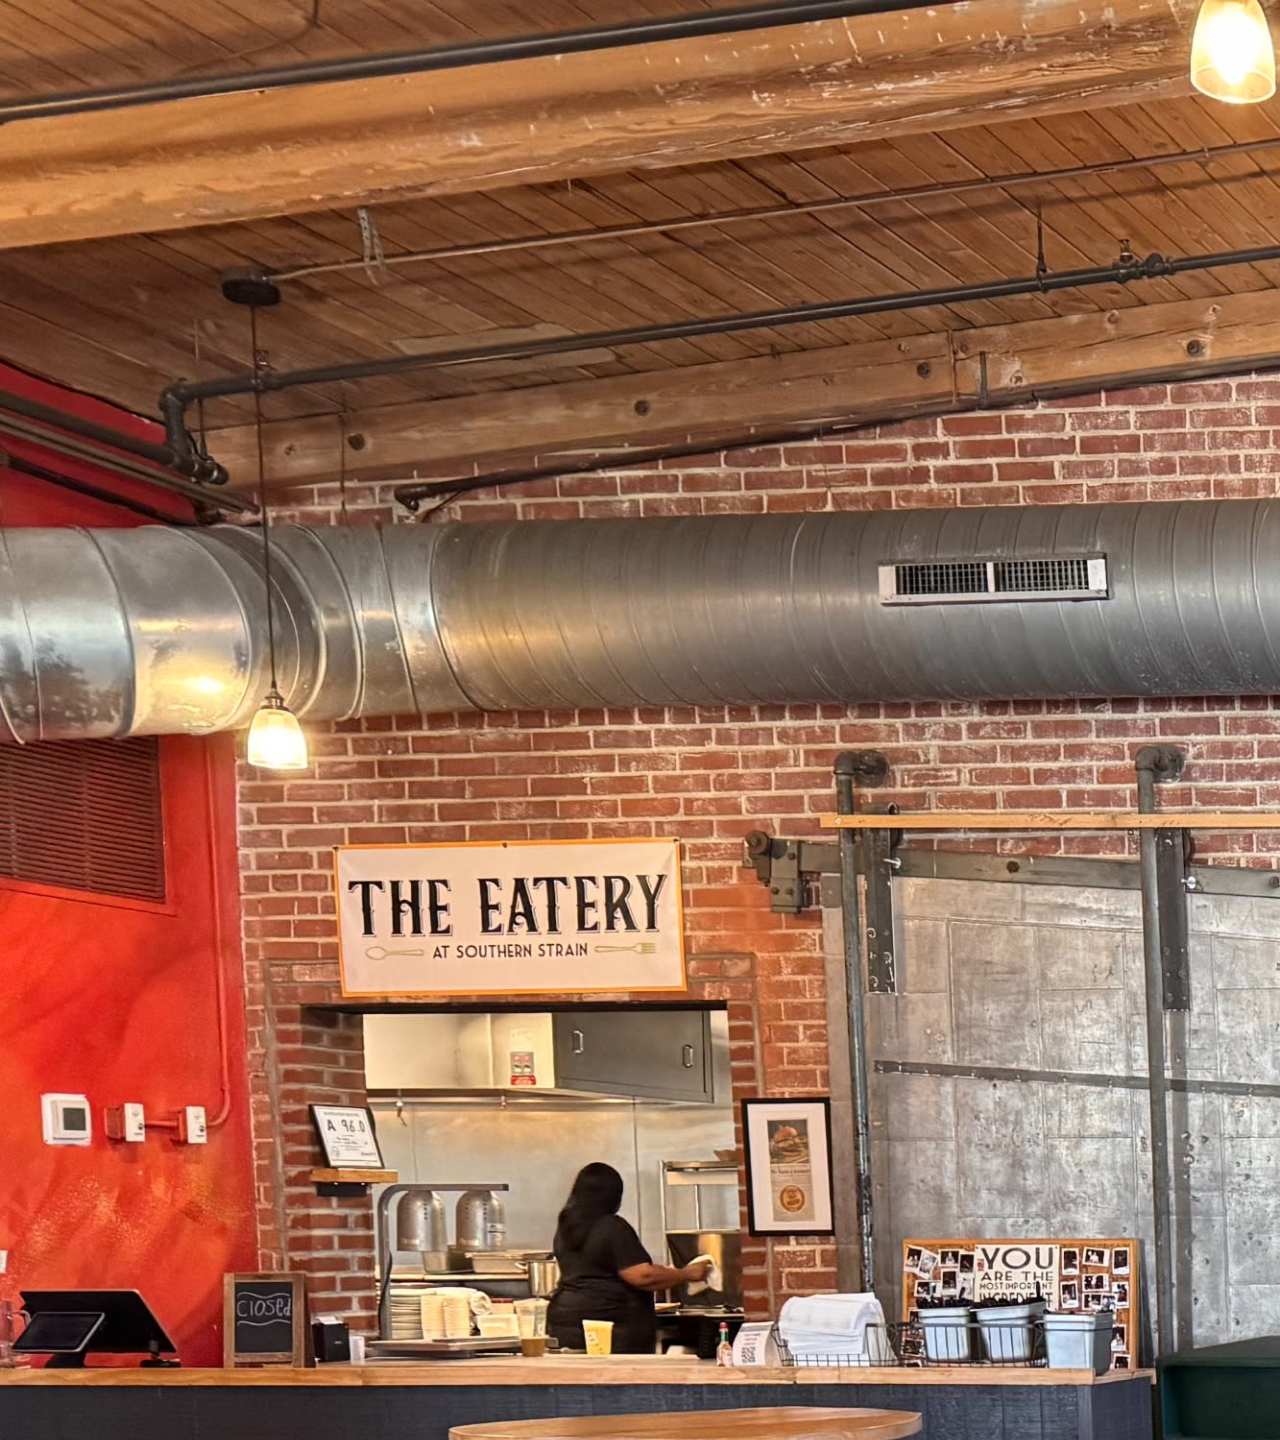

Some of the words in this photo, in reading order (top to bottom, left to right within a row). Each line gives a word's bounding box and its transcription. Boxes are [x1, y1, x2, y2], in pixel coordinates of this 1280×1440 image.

[348, 879, 453, 937] THE
[477, 874, 667, 937] EATERY
[432, 946, 450, 959] AT
[456, 944, 532, 958] SOUTHERN
[538, 943, 588, 957] STRAIN
[328, 1120, 336, 1132] A
[980, 1248, 1054, 1270] YOU
[982, 1271, 1013, 1281] ARE
[1022, 1271, 1053, 1281] THE
[980, 1282, 1003, 1290] MOST
[1006, 1282, 1052, 1290] IMPORTNT
